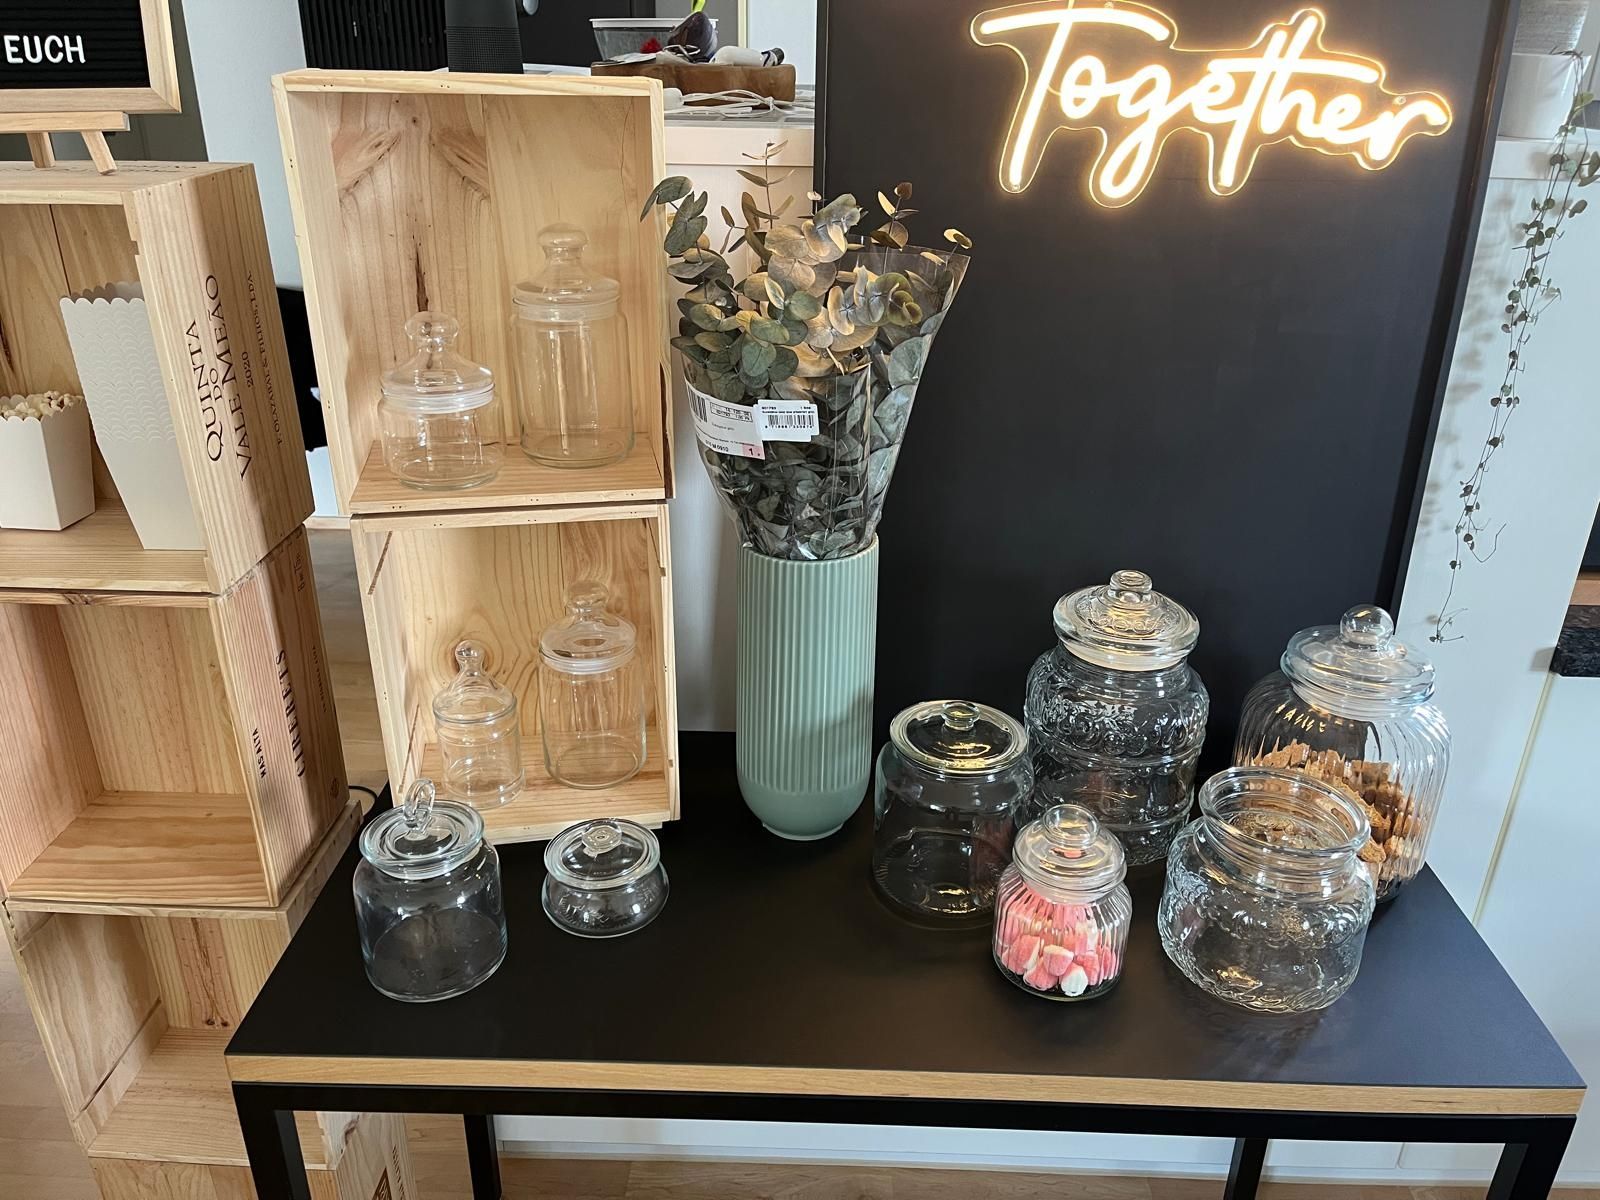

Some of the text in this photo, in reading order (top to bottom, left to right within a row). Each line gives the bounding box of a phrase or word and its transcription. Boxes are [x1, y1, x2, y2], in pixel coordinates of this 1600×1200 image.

[3, 34, 86, 64] EUCH
[975, 5, 1451, 201] Together
[186, 319, 223, 462] QUINTA
[205, 274, 252, 480] VALE MEÃO
[209, 367, 223, 401] DO
[241, 351, 255, 388] 2020
[252, 727, 268, 779] MAS ALTA
[275, 649, 306, 777] CIRERETS
